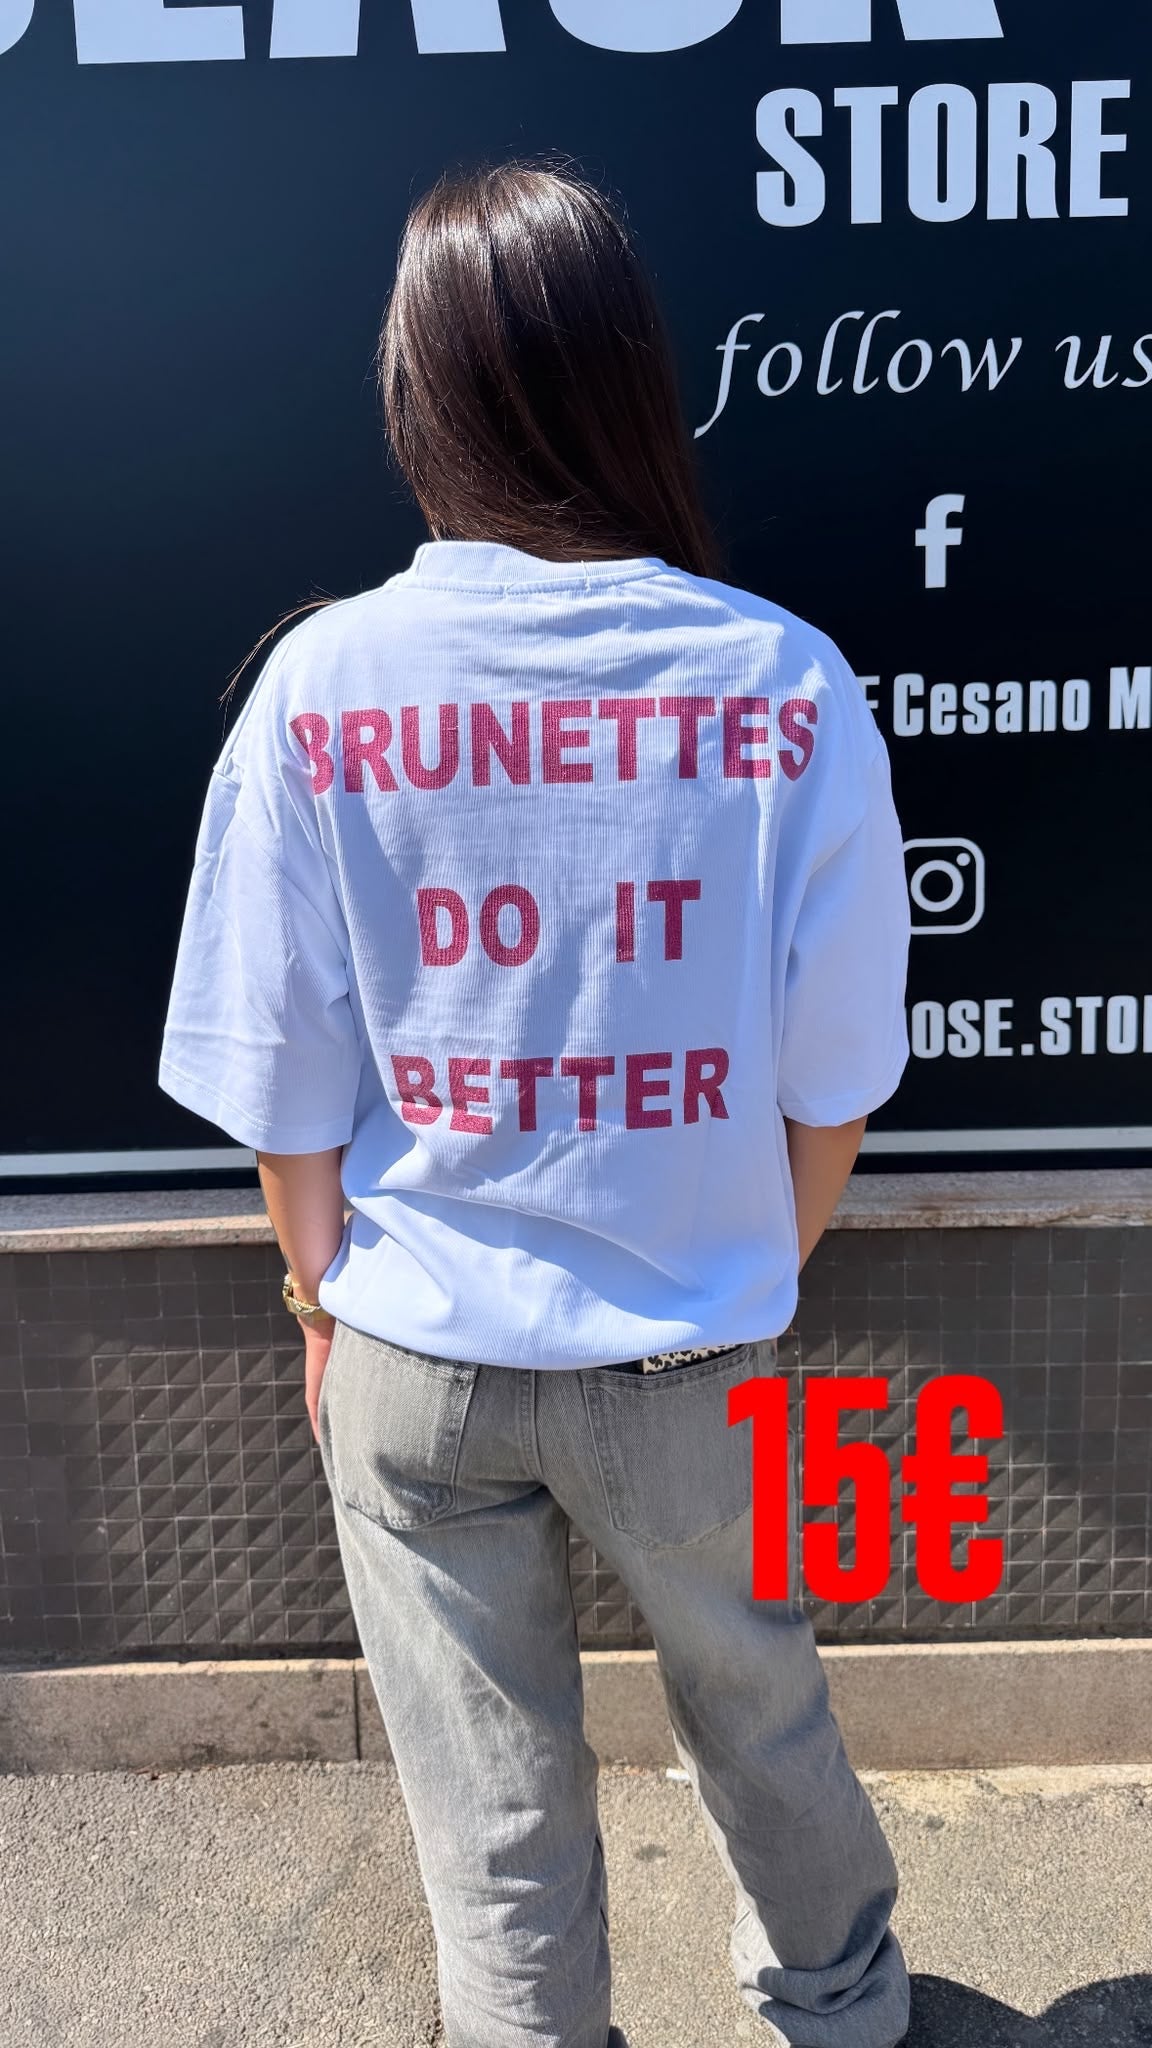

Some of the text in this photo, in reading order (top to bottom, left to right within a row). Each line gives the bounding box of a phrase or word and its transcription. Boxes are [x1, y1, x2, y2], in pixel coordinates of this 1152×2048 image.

[755, 79, 1132, 228] STORE
[693, 310, 1152, 440] follow us
[288, 696, 819, 797] BRUNETTES
[893, 673, 1092, 738] Cesano
[416, 879, 702, 968] DO IT
[390, 1047, 730, 1136] BETTER
